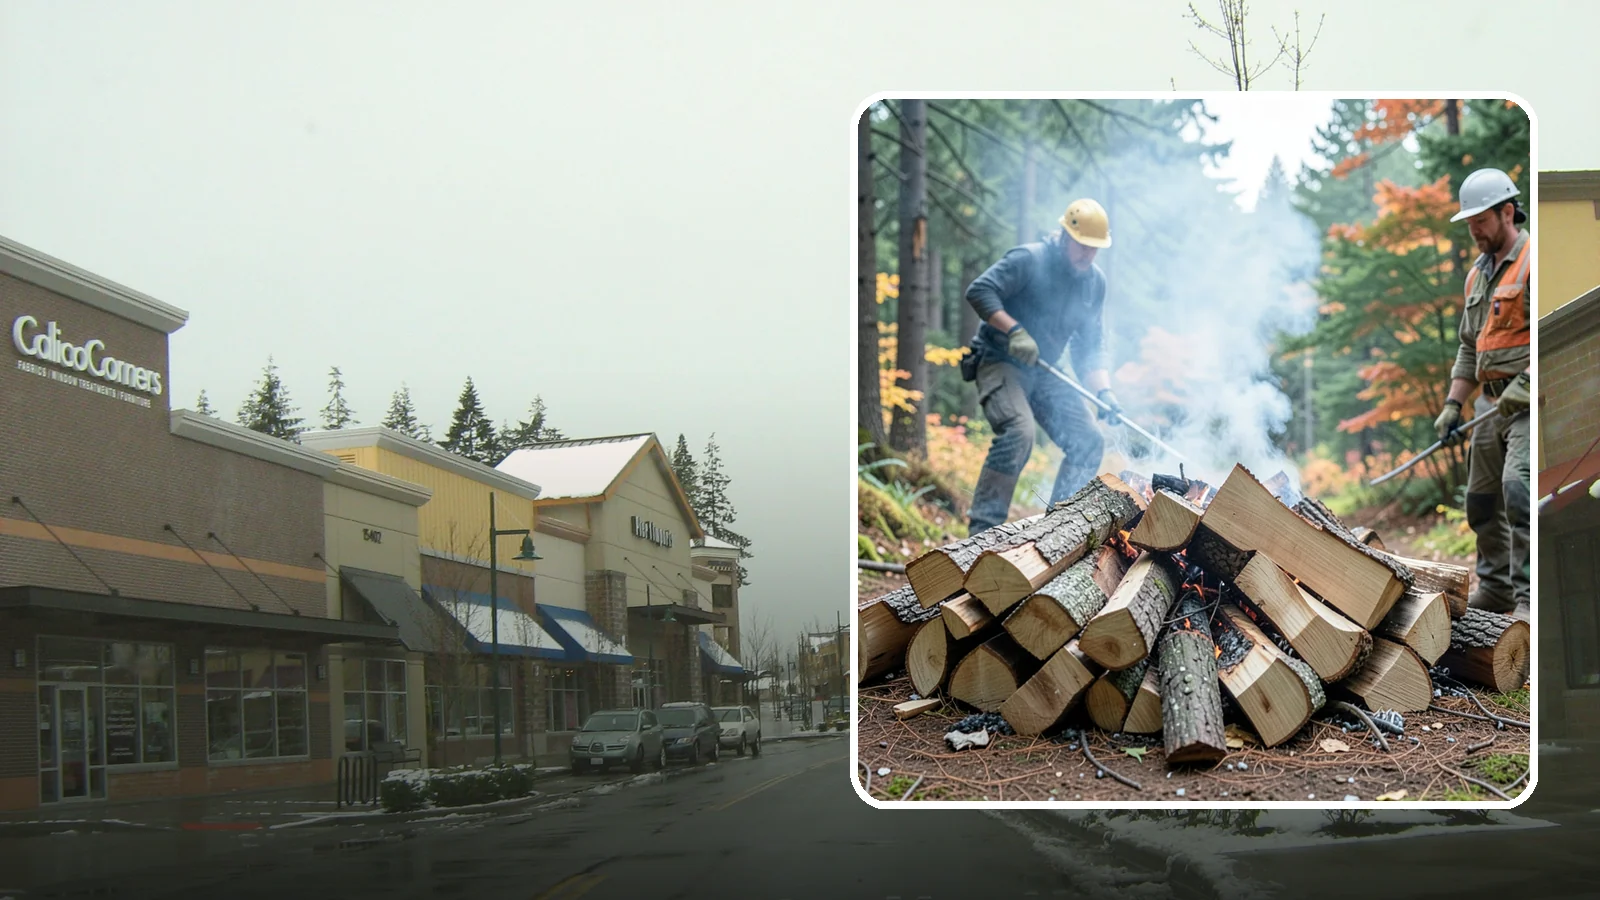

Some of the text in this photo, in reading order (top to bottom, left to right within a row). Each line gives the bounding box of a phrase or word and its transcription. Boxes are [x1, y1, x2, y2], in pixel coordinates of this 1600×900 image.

[17, 360, 151, 408] FABRICS WINDOW TREATMENTS FURNITURE
